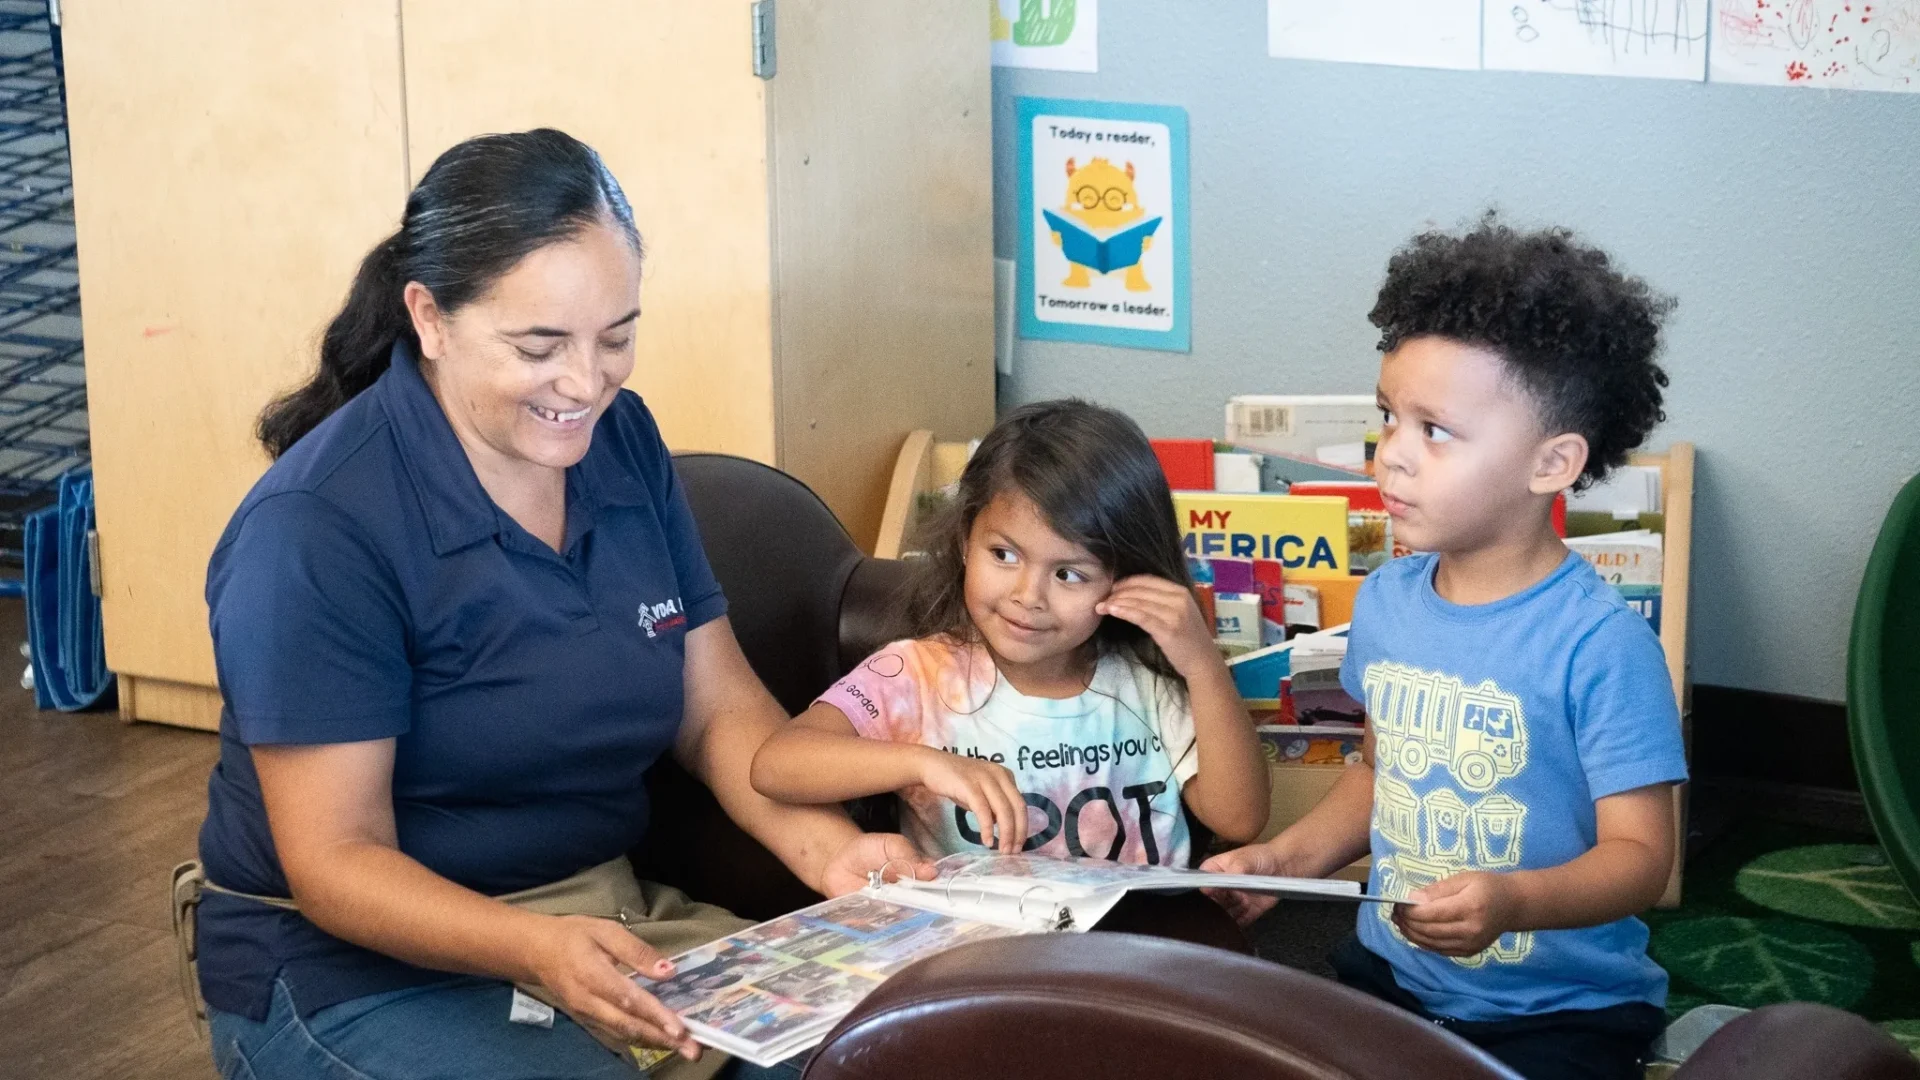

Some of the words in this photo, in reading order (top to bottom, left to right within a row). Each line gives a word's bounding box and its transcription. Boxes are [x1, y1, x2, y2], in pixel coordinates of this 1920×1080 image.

[1049, 125, 1092, 144] Today
[1095, 131, 1104, 142] a
[1106, 131, 1156, 148] reader,
[1038, 294, 1109, 311] Tomorrow
[1111, 302, 1120, 313] a
[1123, 301, 1171, 318] leader.
[1189, 509, 1232, 530] MY
[846, 684, 880, 719] Gordon
[1016, 742, 1111, 775] feelings
[1112, 740, 1147, 765] you
